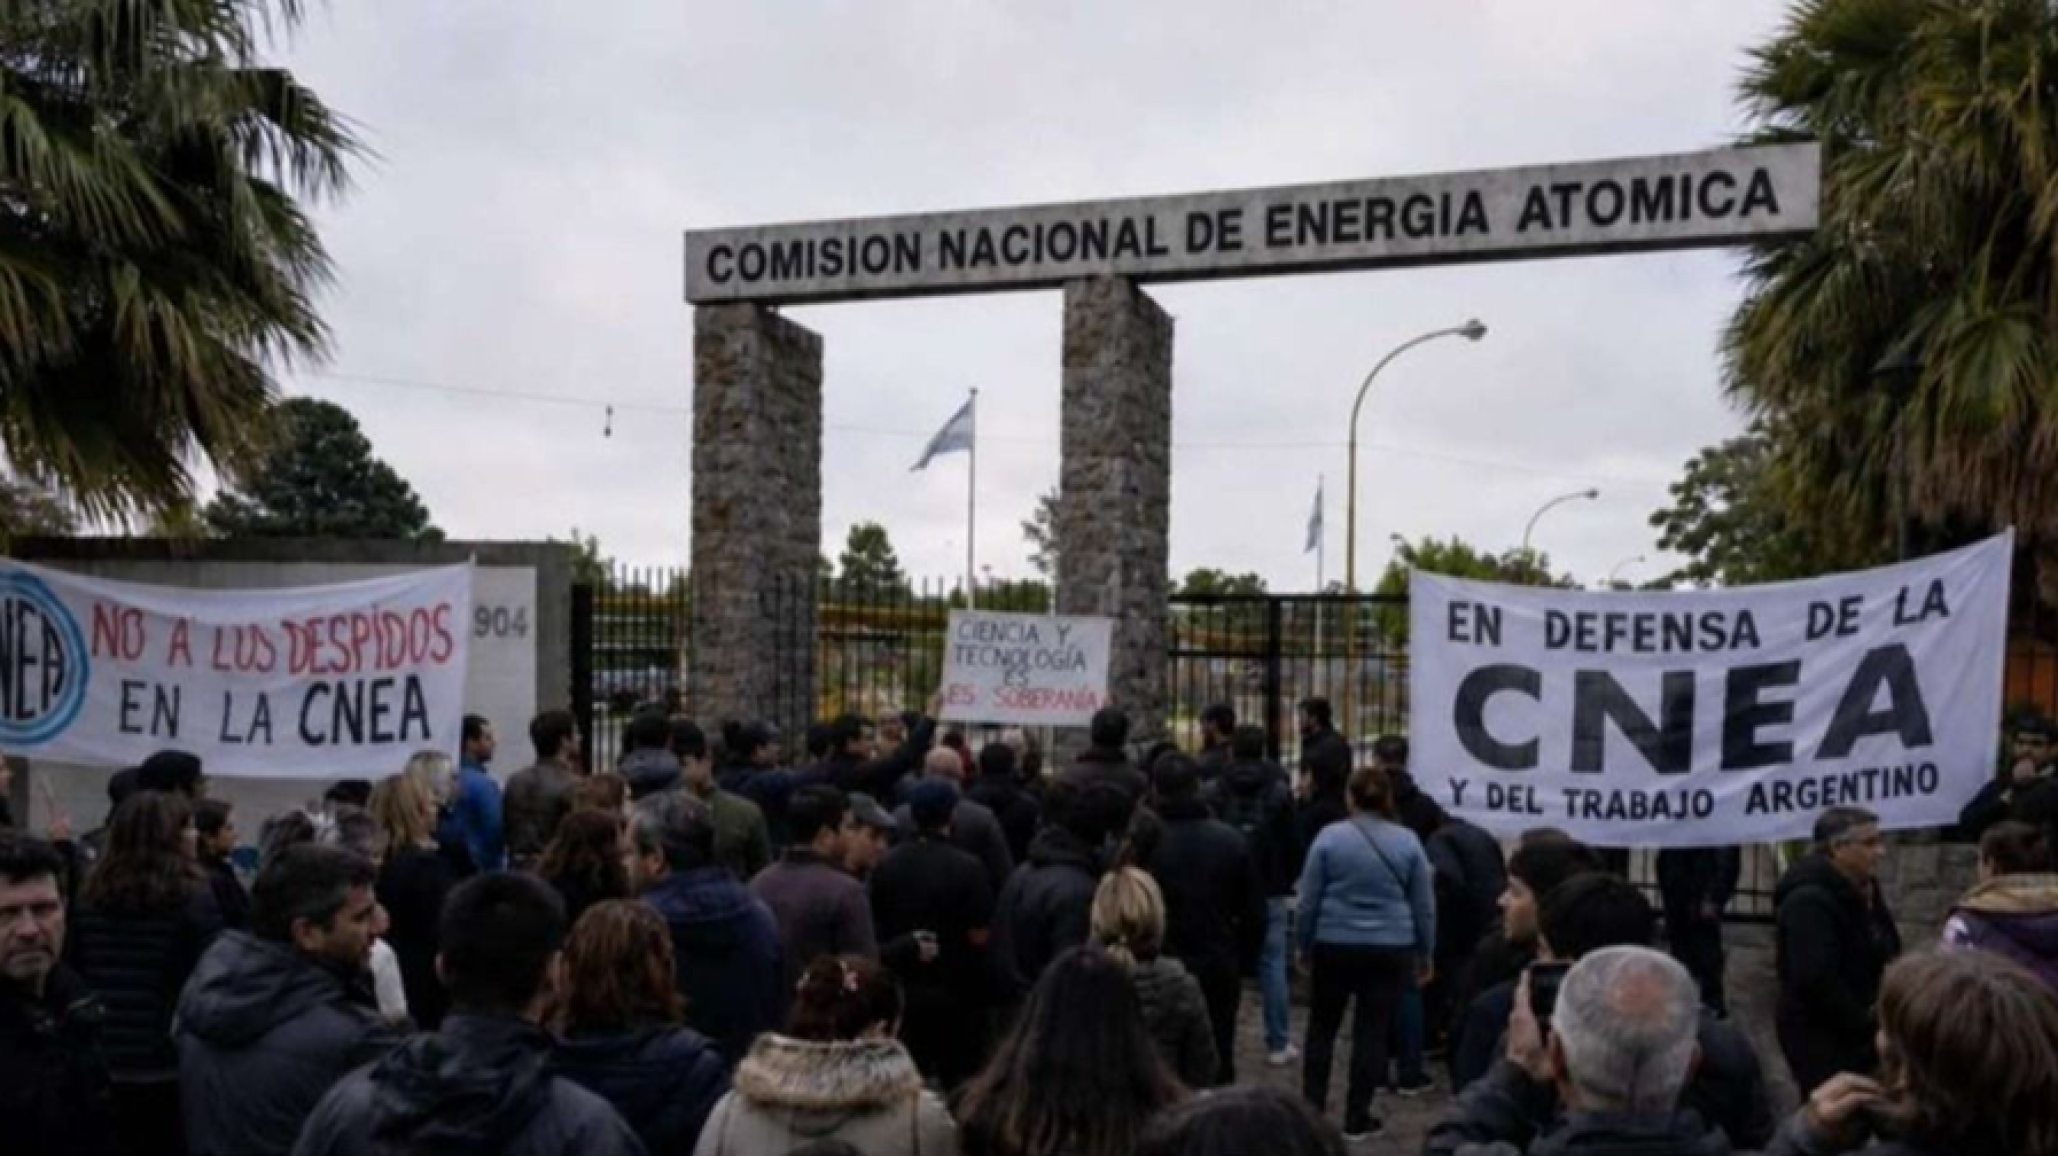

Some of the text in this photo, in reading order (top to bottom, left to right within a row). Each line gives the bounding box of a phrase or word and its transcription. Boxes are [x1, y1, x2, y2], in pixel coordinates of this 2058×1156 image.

[706, 168, 1780, 284] COMISION NACIONAL DE ENERGIA ATOMICA
[92, 602, 146, 662] NO
[168, 616, 193, 668] A
[474, 605, 530, 638] 904
[957, 618, 1072, 646] CIENCIA Y
[1447, 579, 1949, 652] EN DEFENSA DE LA
[120, 675, 431, 746] EN LA CNEA
[1452, 642, 1933, 775] CNEA
[1448, 763, 1939, 821] Y DEL TRABAJO ARGENTINO
